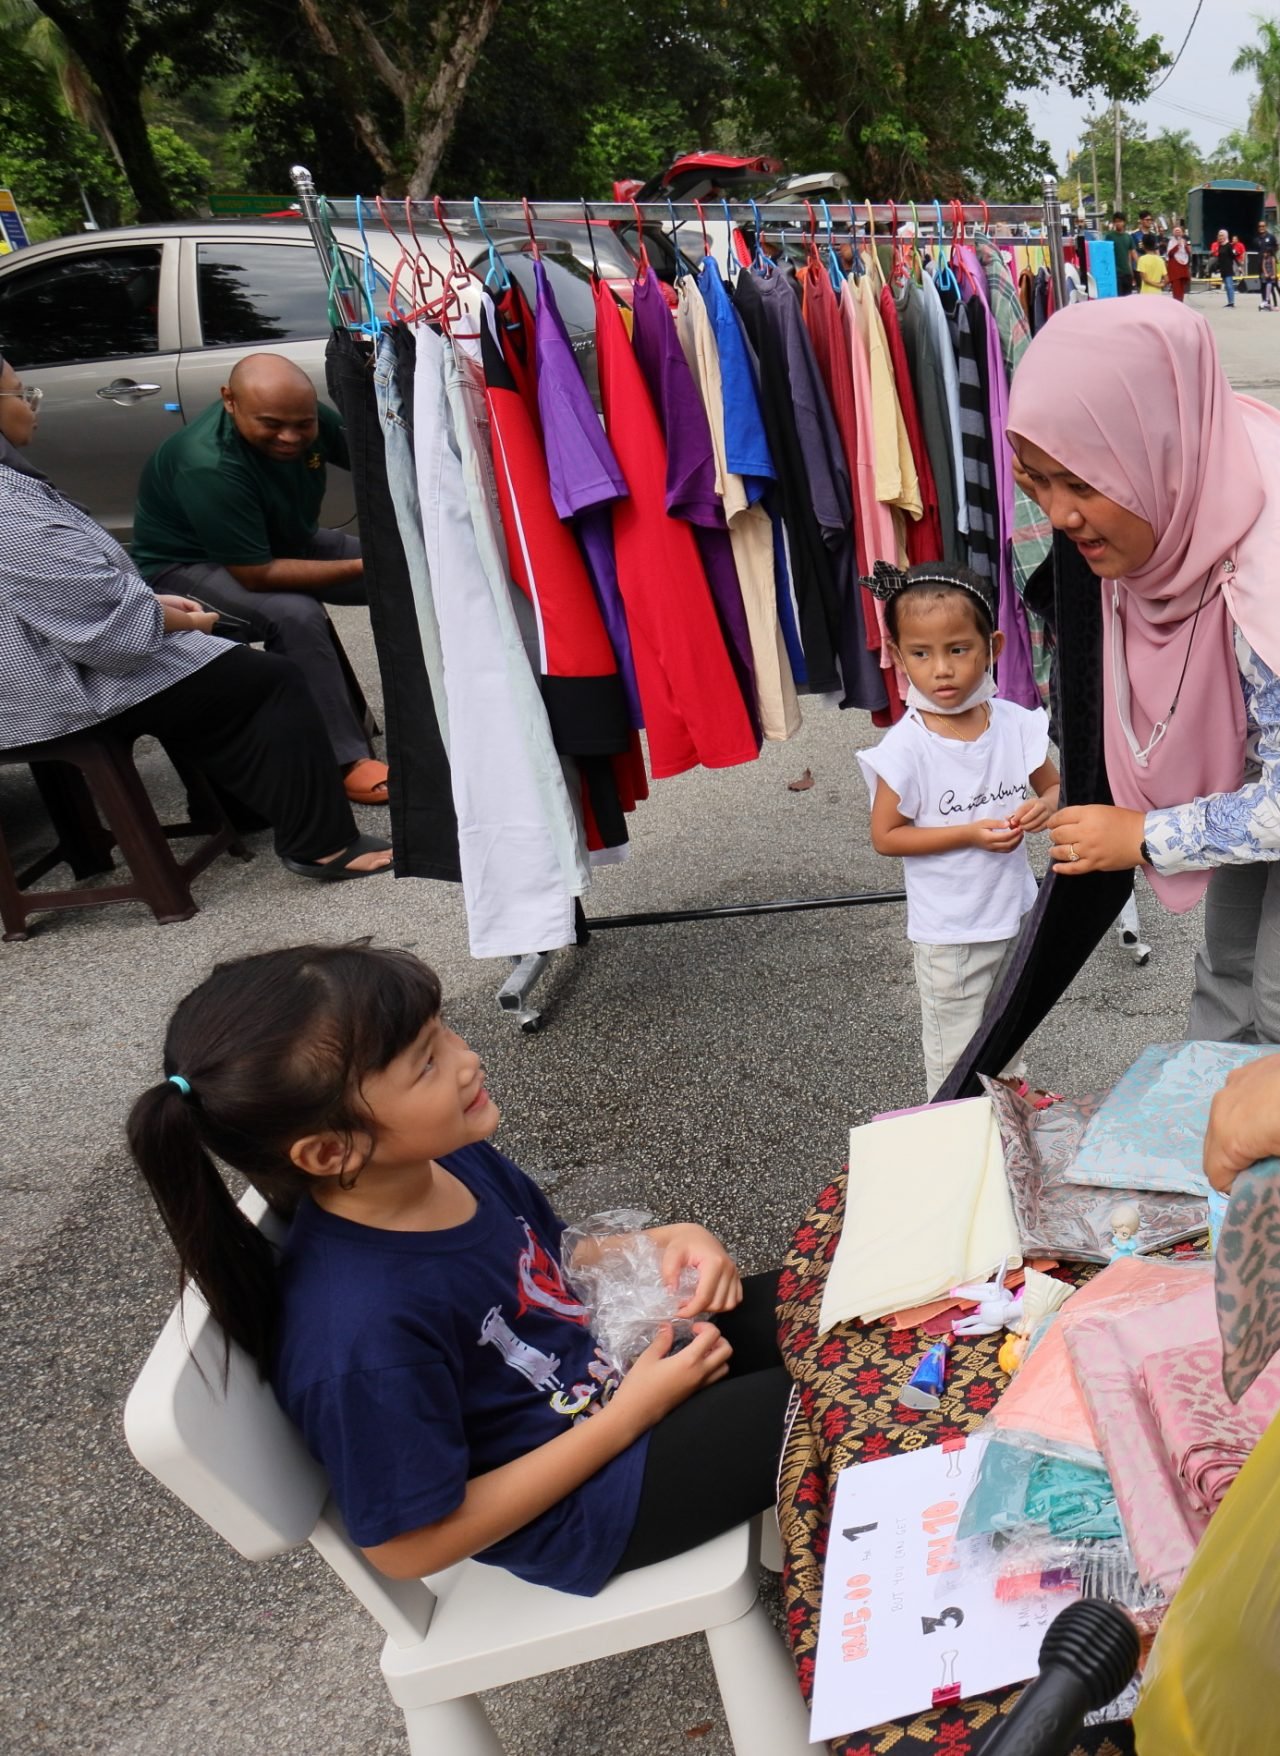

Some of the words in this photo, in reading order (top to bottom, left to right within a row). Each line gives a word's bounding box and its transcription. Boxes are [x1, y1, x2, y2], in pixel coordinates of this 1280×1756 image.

[939, 781, 1027, 816] Canterbury
[841, 1521, 878, 1542] 1
[895, 1517, 907, 1536] GET
[891, 1591, 905, 1613] BUT
[920, 1606, 965, 1636] 3
